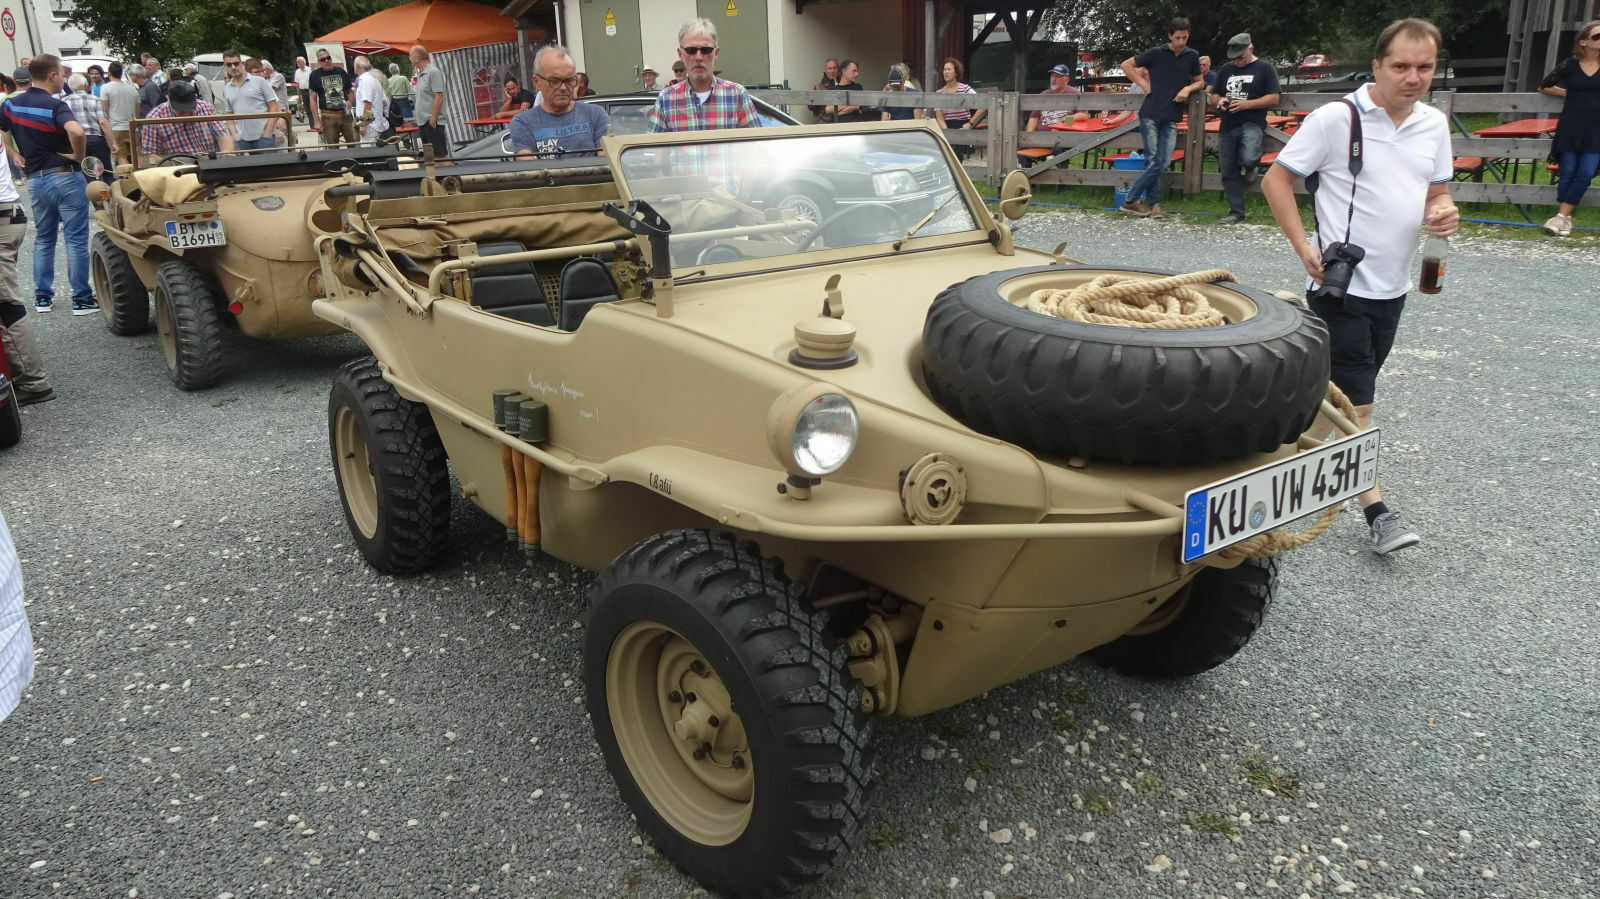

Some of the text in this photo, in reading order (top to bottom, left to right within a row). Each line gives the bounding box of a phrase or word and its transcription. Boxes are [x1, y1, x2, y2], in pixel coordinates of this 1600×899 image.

[4, 17, 12, 30] 30
[536, 138, 558, 149] PLAY
[180, 223, 195, 234] BT
[171, 233, 215, 247] B169H
[1365, 437, 1375, 452] 04
[1363, 468, 1373, 484] 10
[1208, 444, 1362, 545] KU VW 43H
[1191, 532, 1200, 548] D
